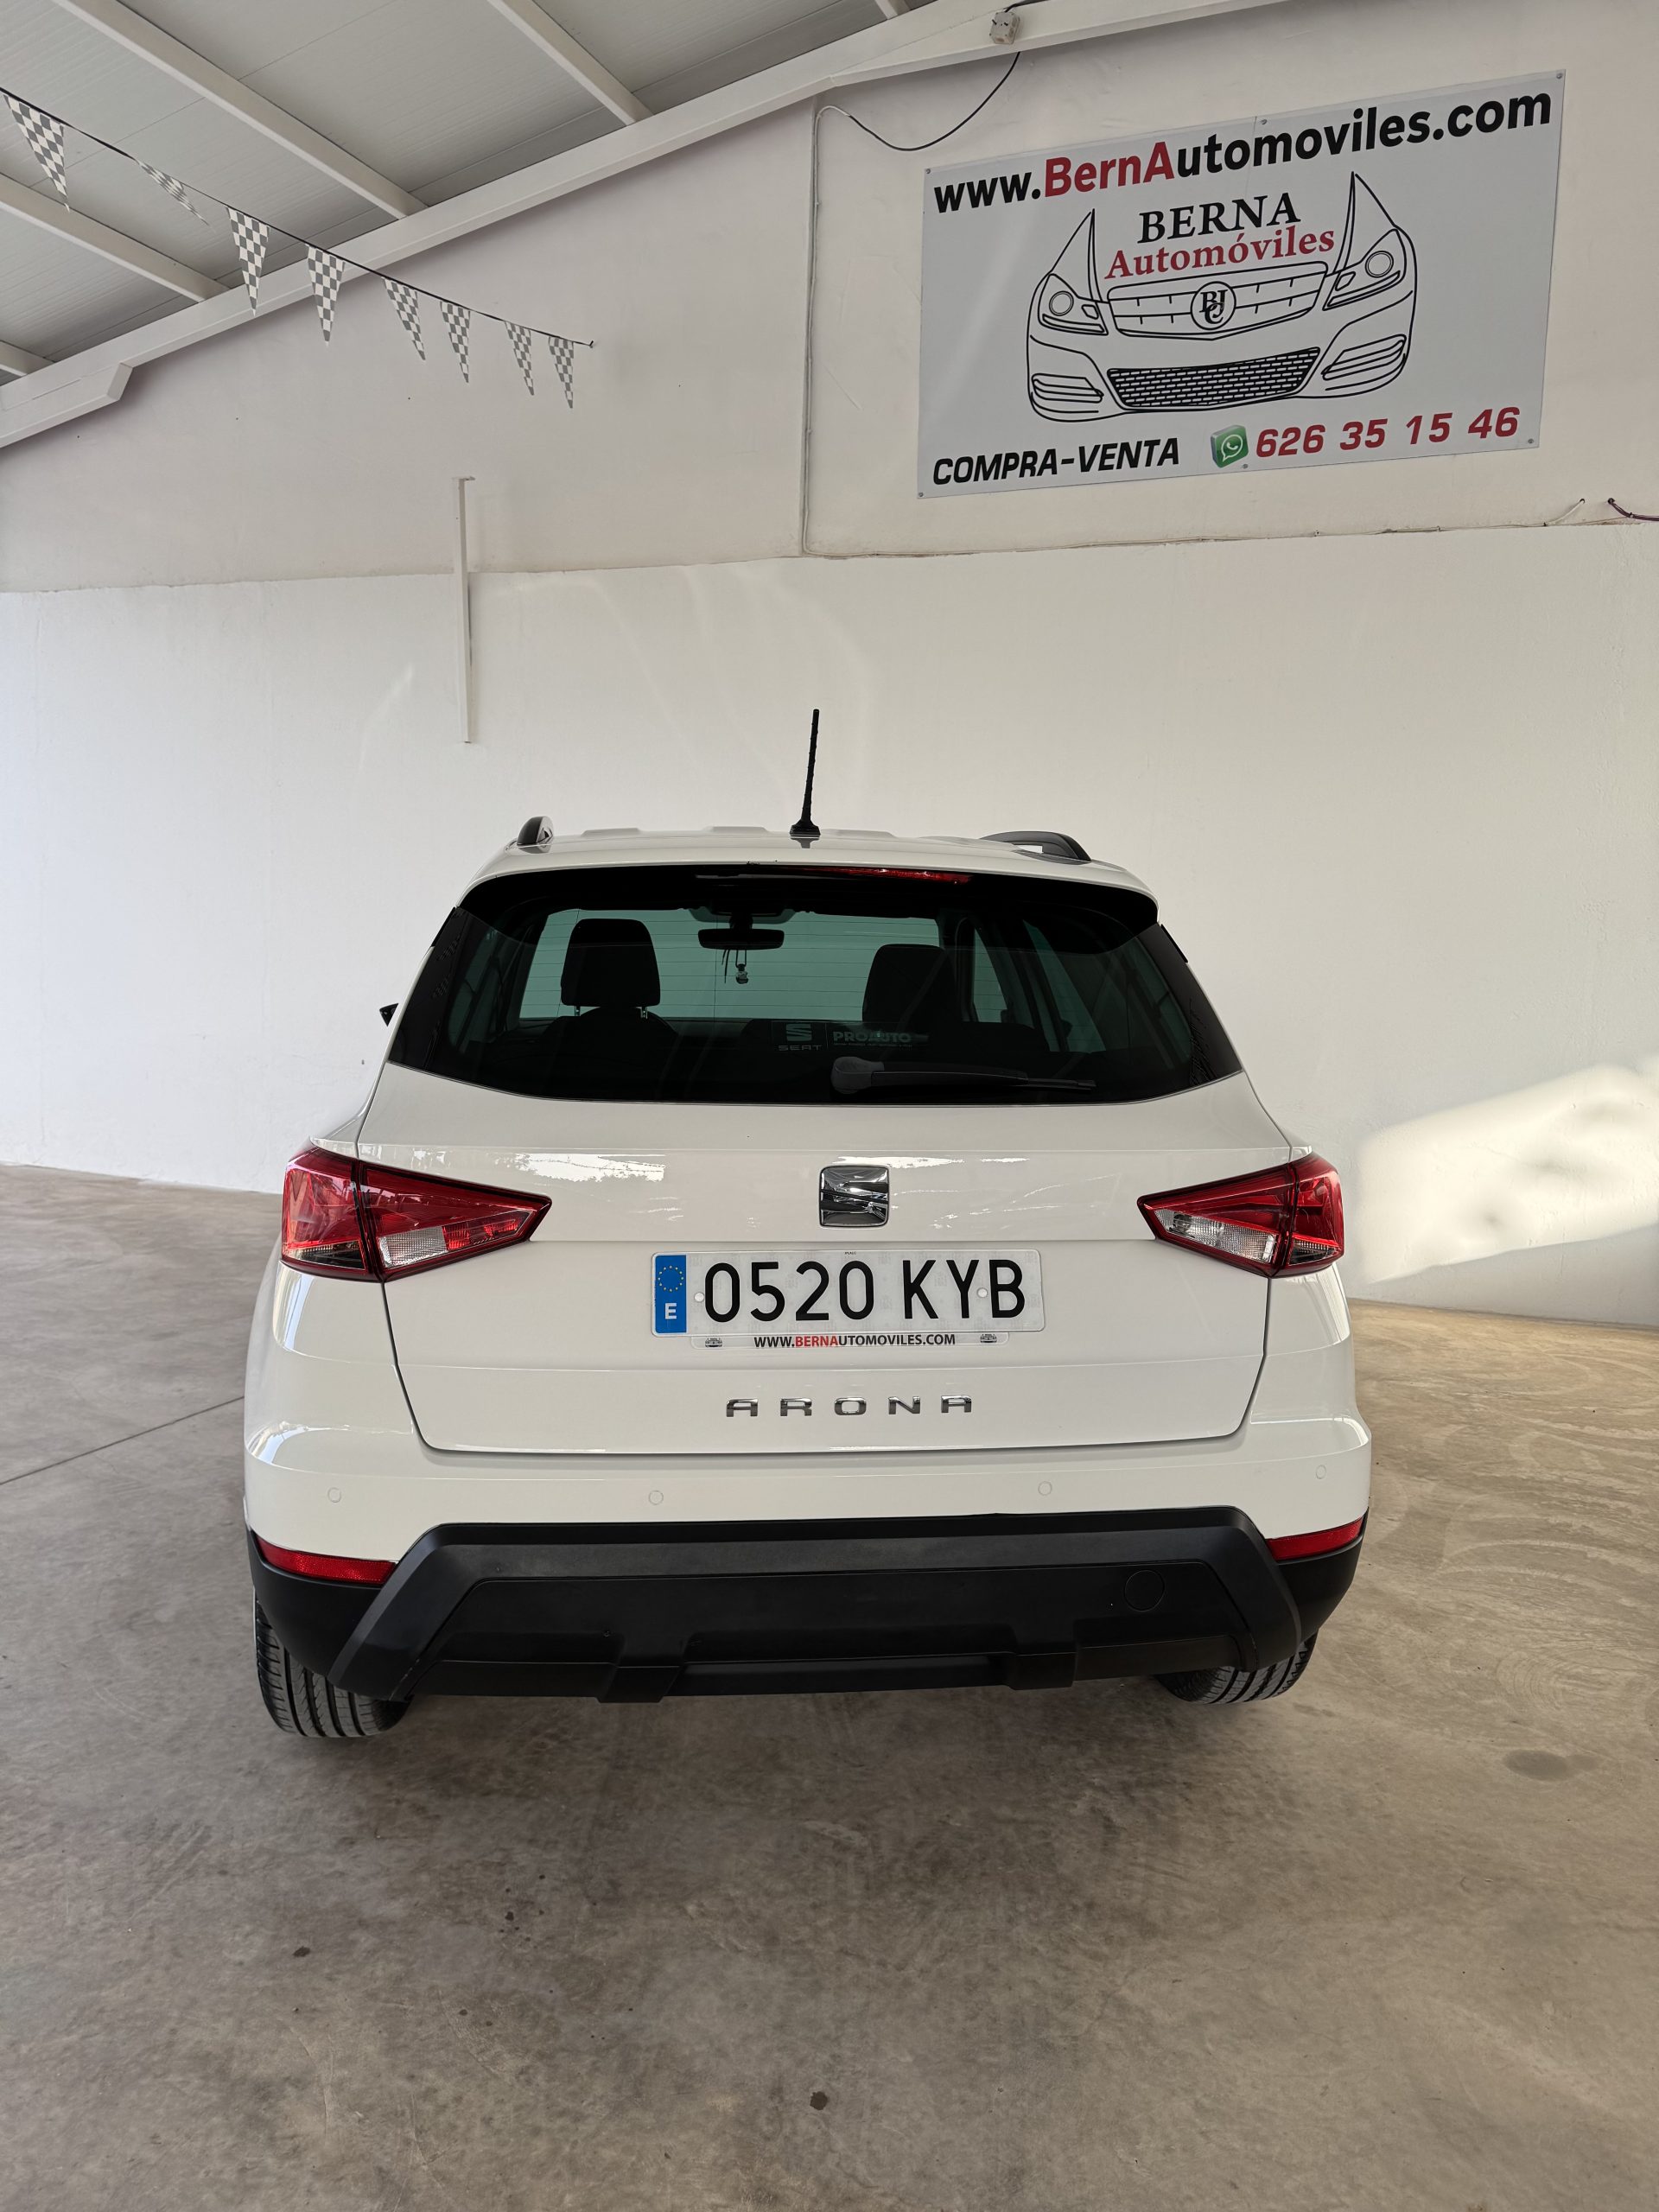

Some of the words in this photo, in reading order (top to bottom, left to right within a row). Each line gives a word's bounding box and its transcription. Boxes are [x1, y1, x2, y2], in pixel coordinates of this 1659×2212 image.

[933, 92, 1552, 213] www.BernAutomoviles.com
[1137, 193, 1300, 244] BERNA
[1104, 227, 1335, 280] Automóviles
[1256, 428, 1325, 459] 626
[1339, 418, 1388, 450] 35
[1406, 414, 1451, 445] 15
[1468, 406, 1520, 438] 46
[933, 437, 1179, 485] COMPRA-VENTA
[664, 1302, 677, 1319] E
[704, 1260, 874, 1322] 0520
[903, 1259, 1026, 1319] KYB
[754, 1333, 956, 1348] WWW.BERNAUTOMOVILES.COM
[726, 1394, 972, 1417] ARONA
